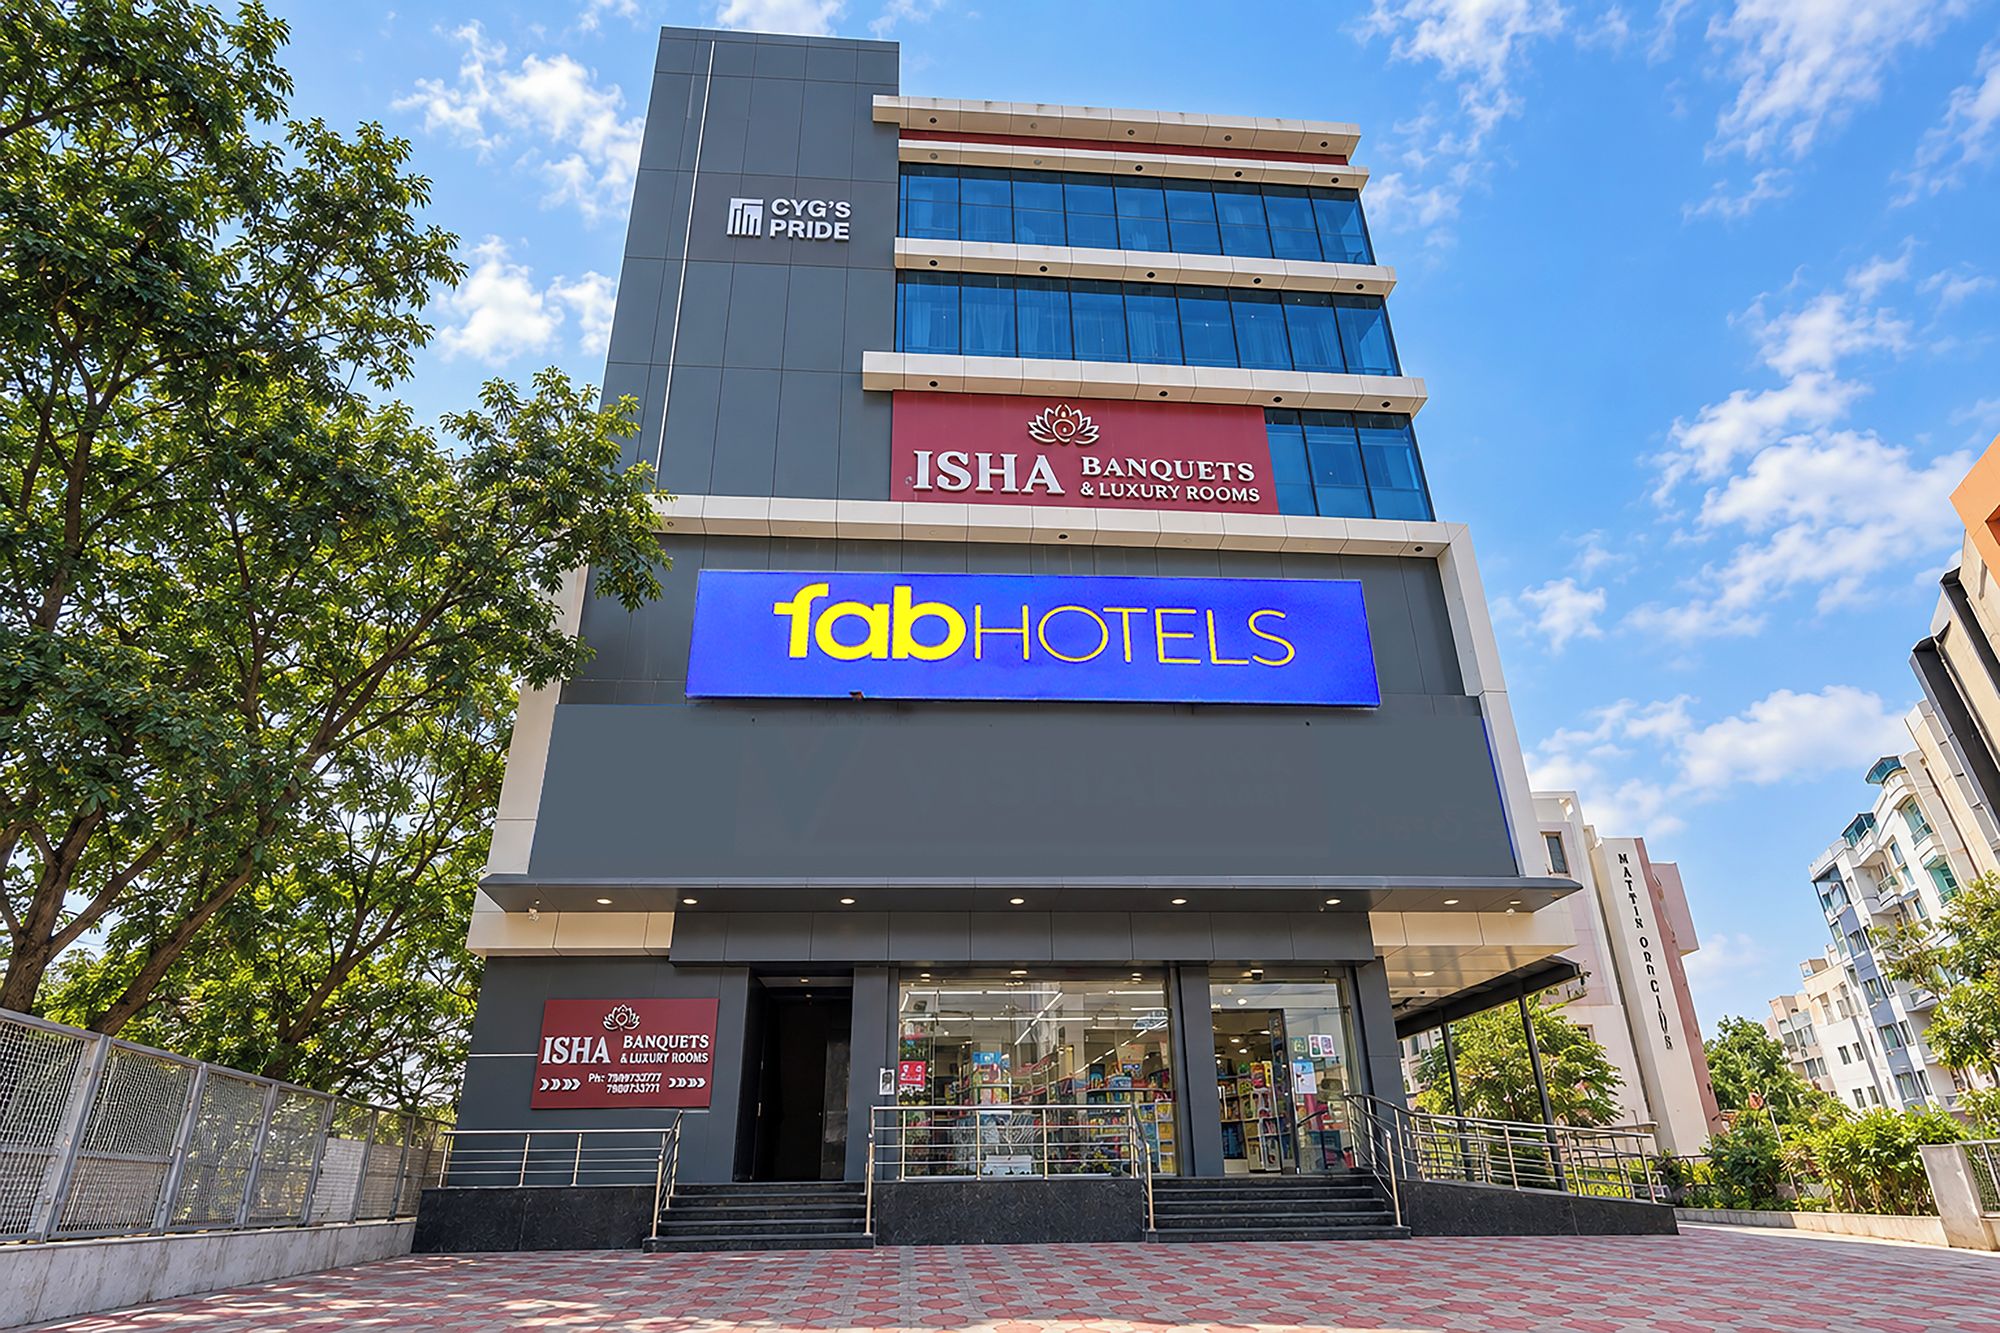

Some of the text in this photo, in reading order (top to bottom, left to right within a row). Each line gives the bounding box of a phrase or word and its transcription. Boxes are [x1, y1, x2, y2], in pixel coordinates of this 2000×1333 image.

[770, 198, 852, 218] CYG'S
[769, 218, 850, 241] PRIDE
[913, 449, 1256, 495] ISHA BANQUETS
[1079, 481, 1261, 503] & LUXURY ROOMS
[541, 1034, 709, 1065] ISHA BANQUETS
[620, 1052, 709, 1065] & LUXURY ROOMS
